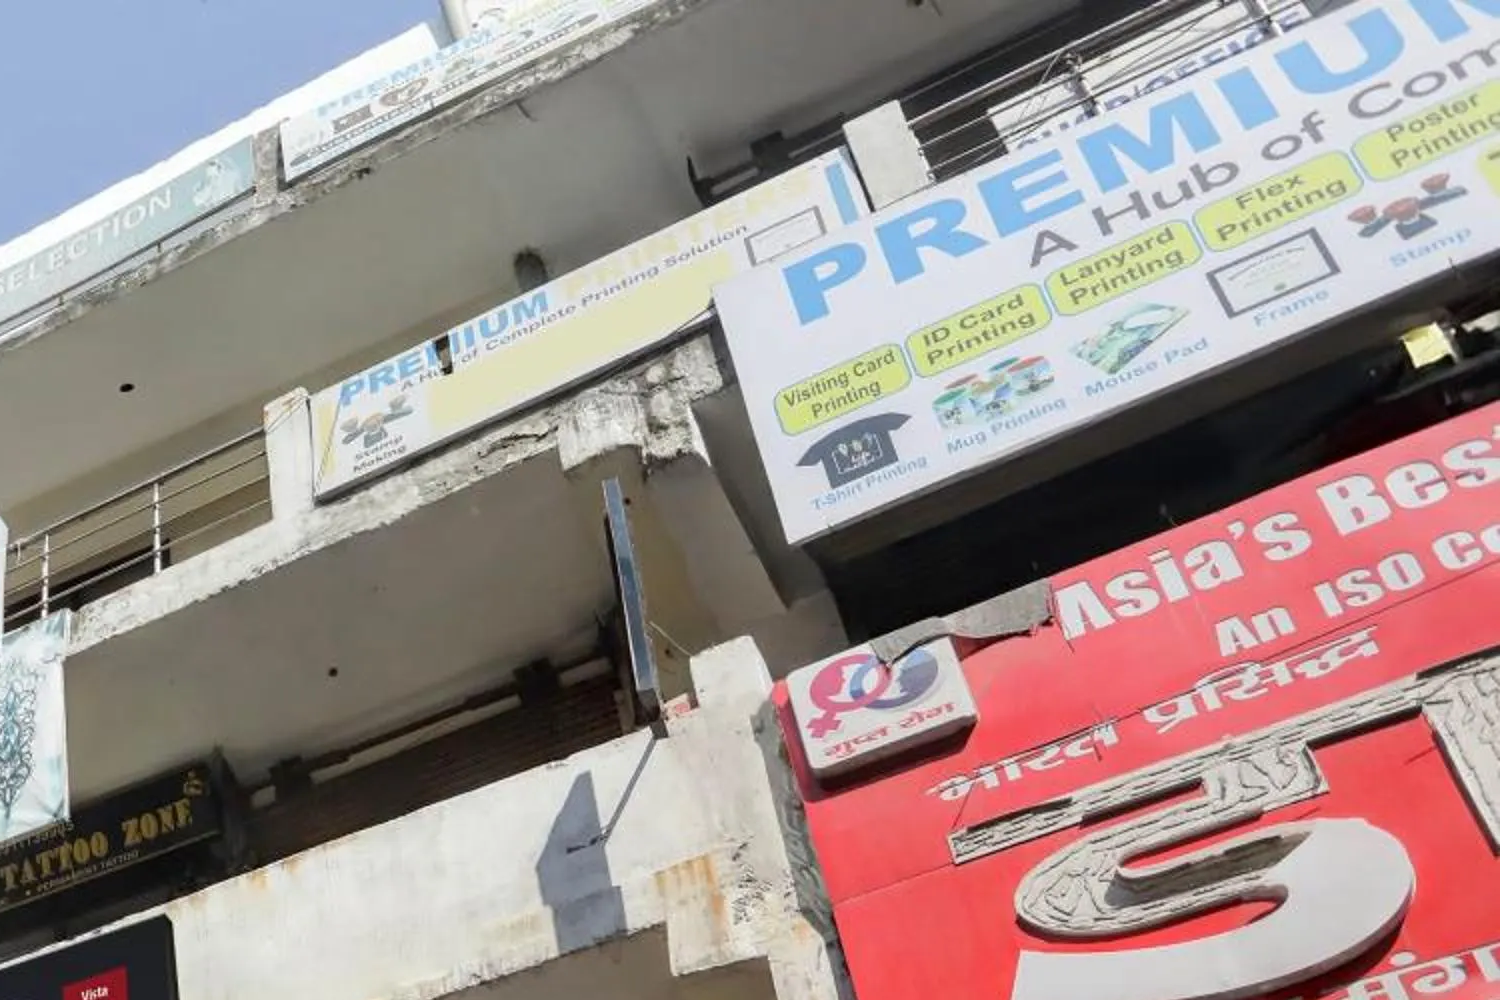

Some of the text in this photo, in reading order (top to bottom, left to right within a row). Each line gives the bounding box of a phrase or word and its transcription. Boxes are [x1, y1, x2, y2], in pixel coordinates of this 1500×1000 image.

[1386, 94, 1479, 142] Poster
[1029, 229, 1079, 268] A
[1091, 158, 1240, 236] Hub
[1260, 110, 1326, 161] of
[1216, 178, 1347, 241] Printing
[1235, 172, 1306, 209] Flex
[1059, 226, 1175, 287] Lanyard
[1389, 225, 1472, 268] Stamp
[486, 305, 576, 351] Complete
[581, 267, 659, 309] Printing
[663, 223, 748, 267] Solution
[1069, 247, 1185, 306] Printing
[922, 293, 1024, 347] ID Card
[1252, 288, 1329, 327] Frame
[926, 312, 1037, 366] Printing
[1084, 336, 1208, 398] Mouse Pad
[783, 350, 895, 407] Visiting Card
[811, 380, 882, 419] Printing
[947, 398, 1067, 455] Mug Printing
[1054, 425, 1500, 642] Asia's Bes
[1215, 607, 1297, 657] An
[1314, 552, 1426, 618] ISO
[0, 831, 109, 891] TATTOO
[122, 798, 193, 847] ZONE
